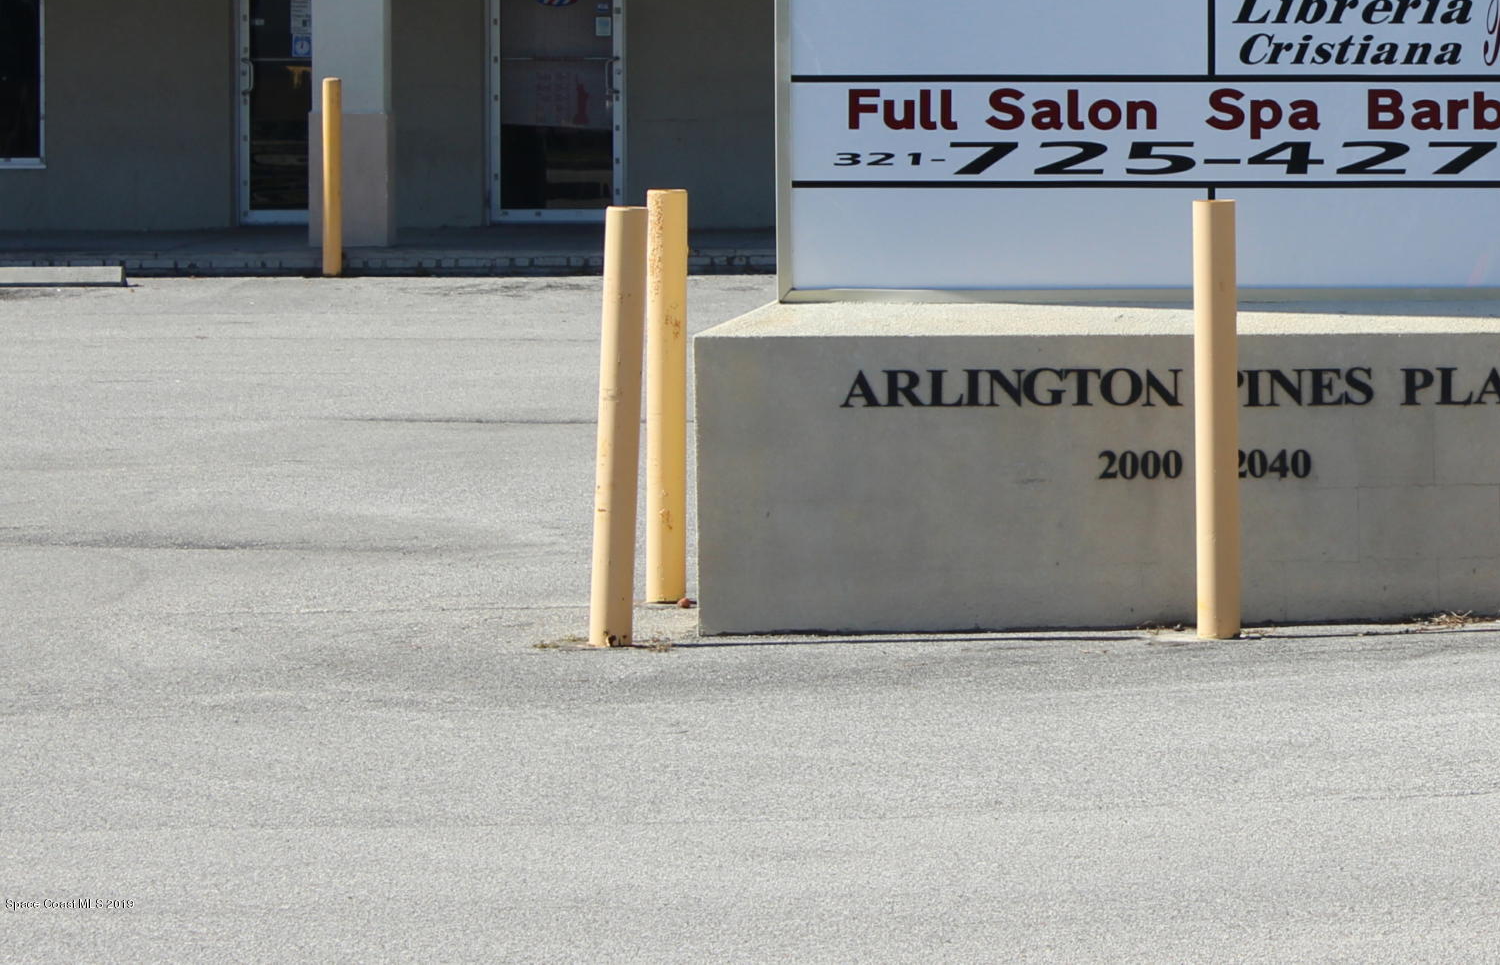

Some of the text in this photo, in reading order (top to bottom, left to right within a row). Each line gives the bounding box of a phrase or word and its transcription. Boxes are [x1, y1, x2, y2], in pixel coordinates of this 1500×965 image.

[1240, 33, 1462, 65] Cristiana
[848, 89, 958, 130] Full
[985, 88, 1157, 130] Salon
[1205, 88, 1320, 140] Spa
[840, 368, 1182, 407] ARLINGTON
[1237, 367, 1375, 407] INES
[1099, 451, 1182, 479] 2000
